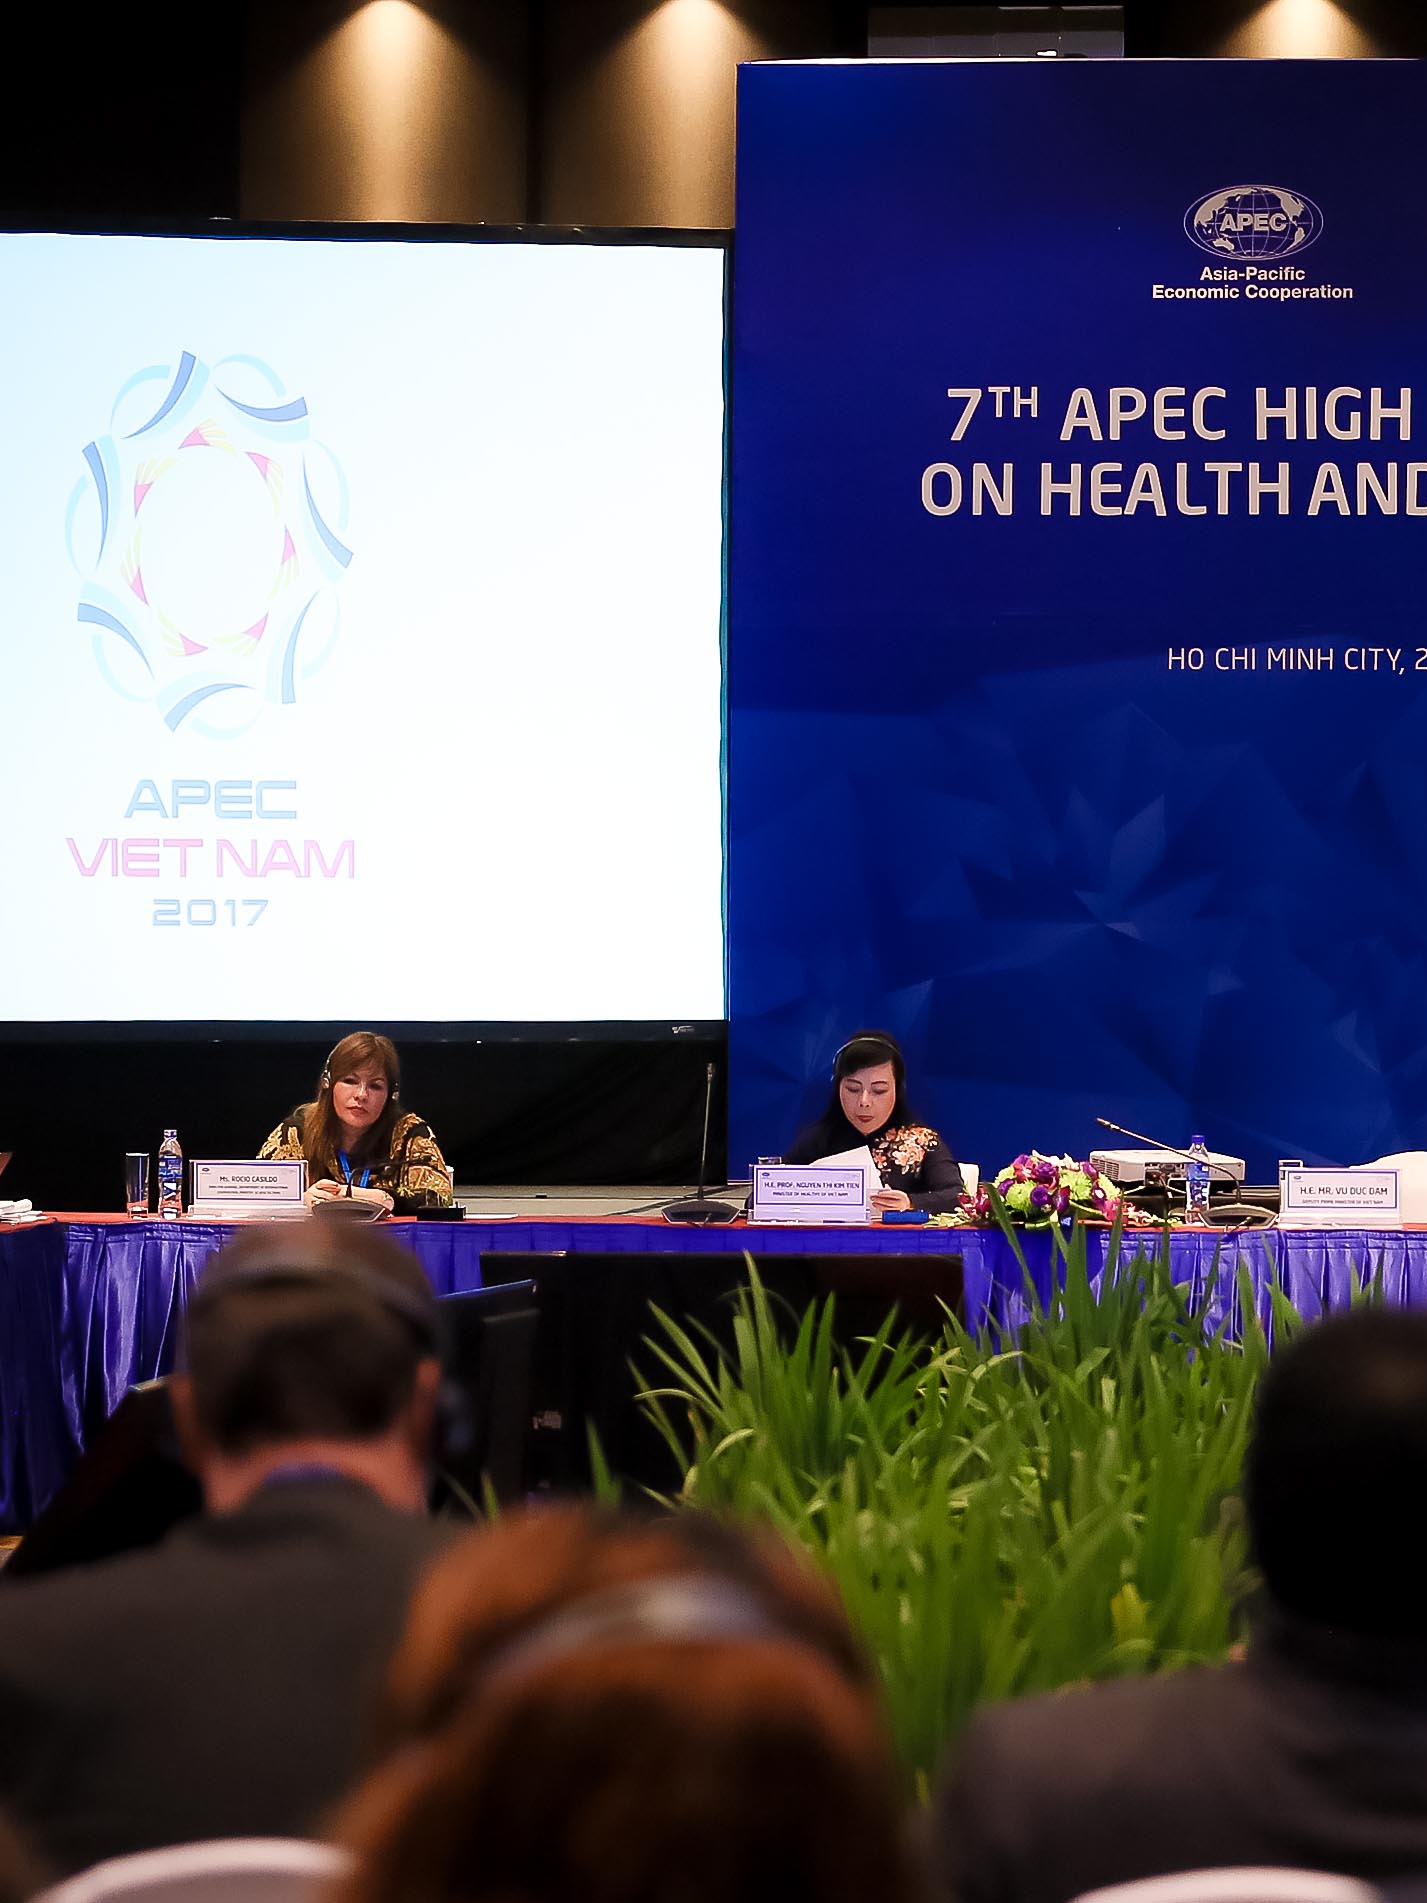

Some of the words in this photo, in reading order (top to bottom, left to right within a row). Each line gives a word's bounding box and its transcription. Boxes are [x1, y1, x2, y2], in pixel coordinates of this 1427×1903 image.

[1220, 213, 1287, 231] APEC
[1200, 266, 1306, 281] Asia-Pacific
[1152, 284, 1240, 299] Economic
[1245, 284, 1353, 302] Cooperation
[948, 386, 1038, 441] 7TH
[1060, 386, 1227, 441] APEC
[1256, 387, 1412, 441] HIGH
[921, 463, 1014, 516] ON
[1040, 462, 1290, 516] HEALTH
[1168, 648, 1203, 670] HO
[1215, 648, 1255, 670] CHI
[1267, 648, 1333, 671] MINH
[1344, 648, 1405, 676] CITY,
[124, 778, 298, 820] APEC
[65, 837, 204, 878] VIET
[216, 839, 357, 879] NAM
[152, 898, 269, 927] 2017
[1335, 1187, 1348, 1195] VU
[1350, 1187, 1367, 1195] DUC
[1369, 1187, 1388, 1195] DAM
